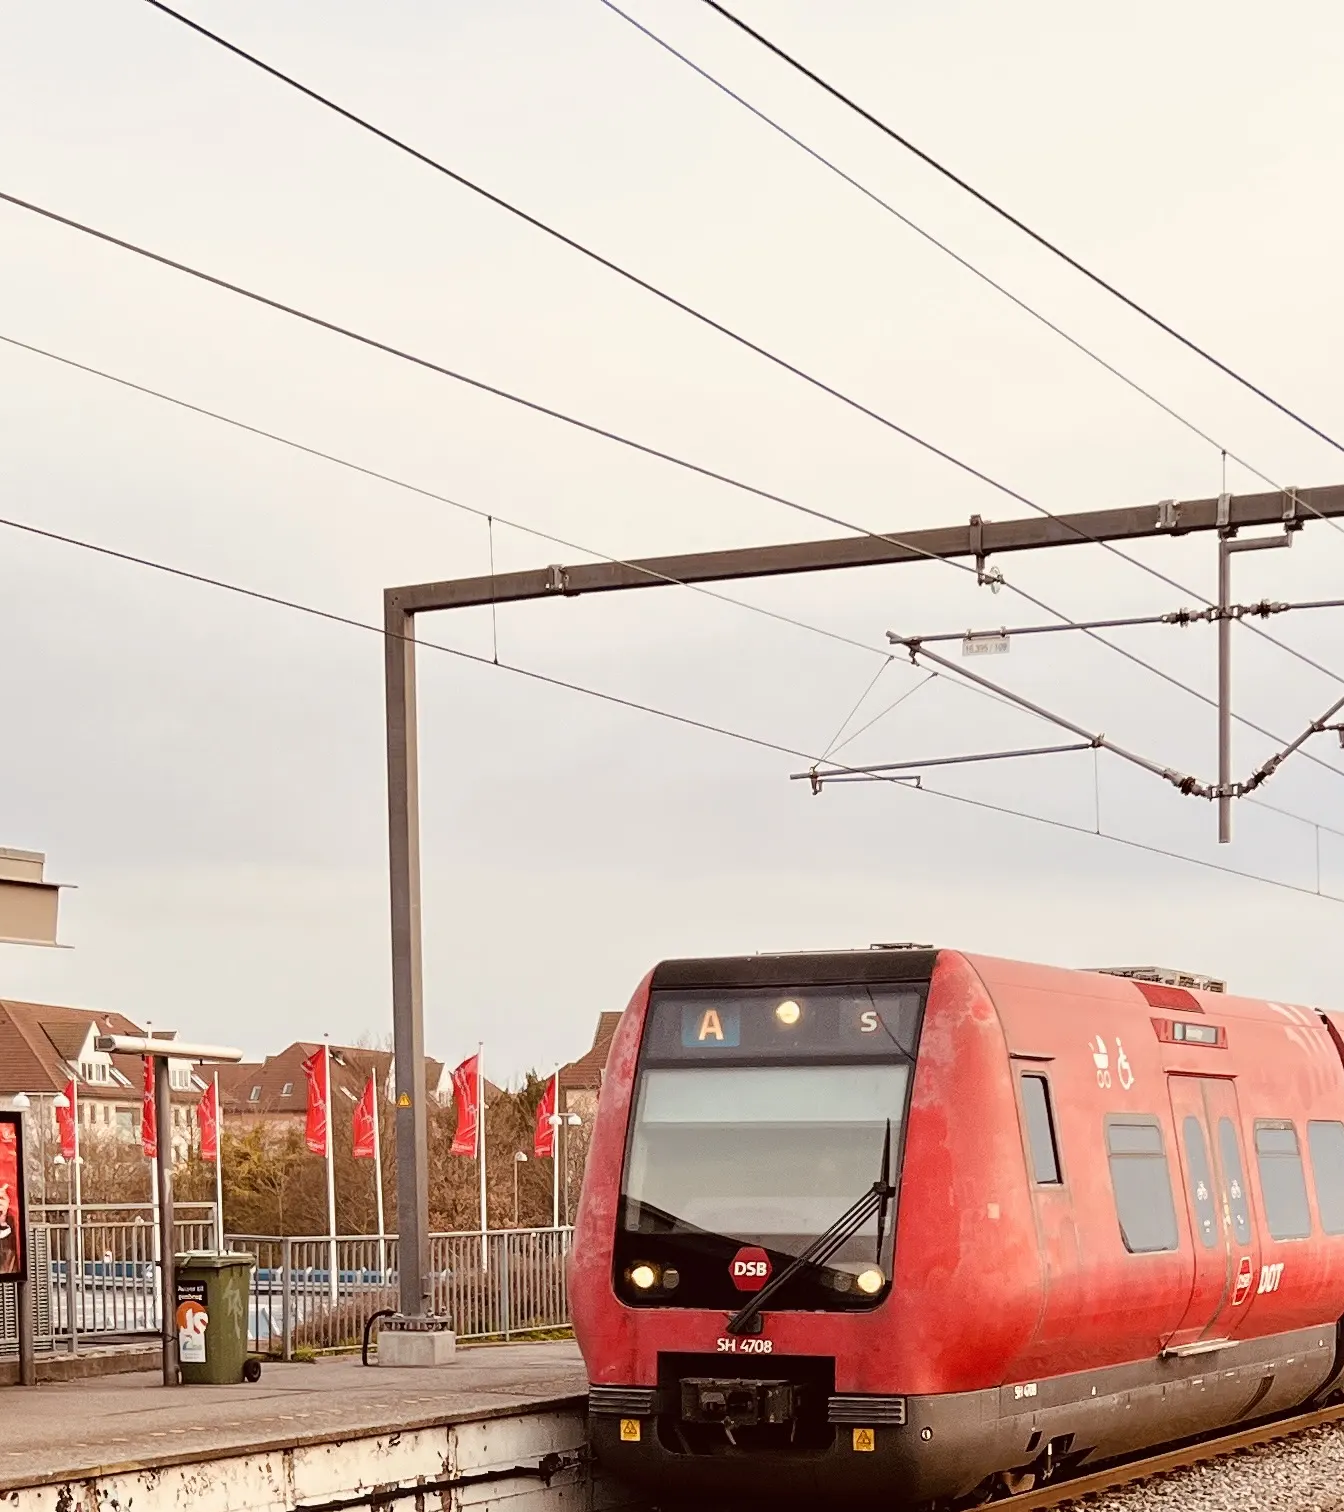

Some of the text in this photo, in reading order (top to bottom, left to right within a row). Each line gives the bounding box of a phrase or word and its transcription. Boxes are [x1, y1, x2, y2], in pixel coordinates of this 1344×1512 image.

[699, 1010, 724, 1040] A
[734, 1261, 767, 1276] DSB
[1257, 1263, 1284, 1294] DOT
[716, 1337, 773, 1353] SH 4708
